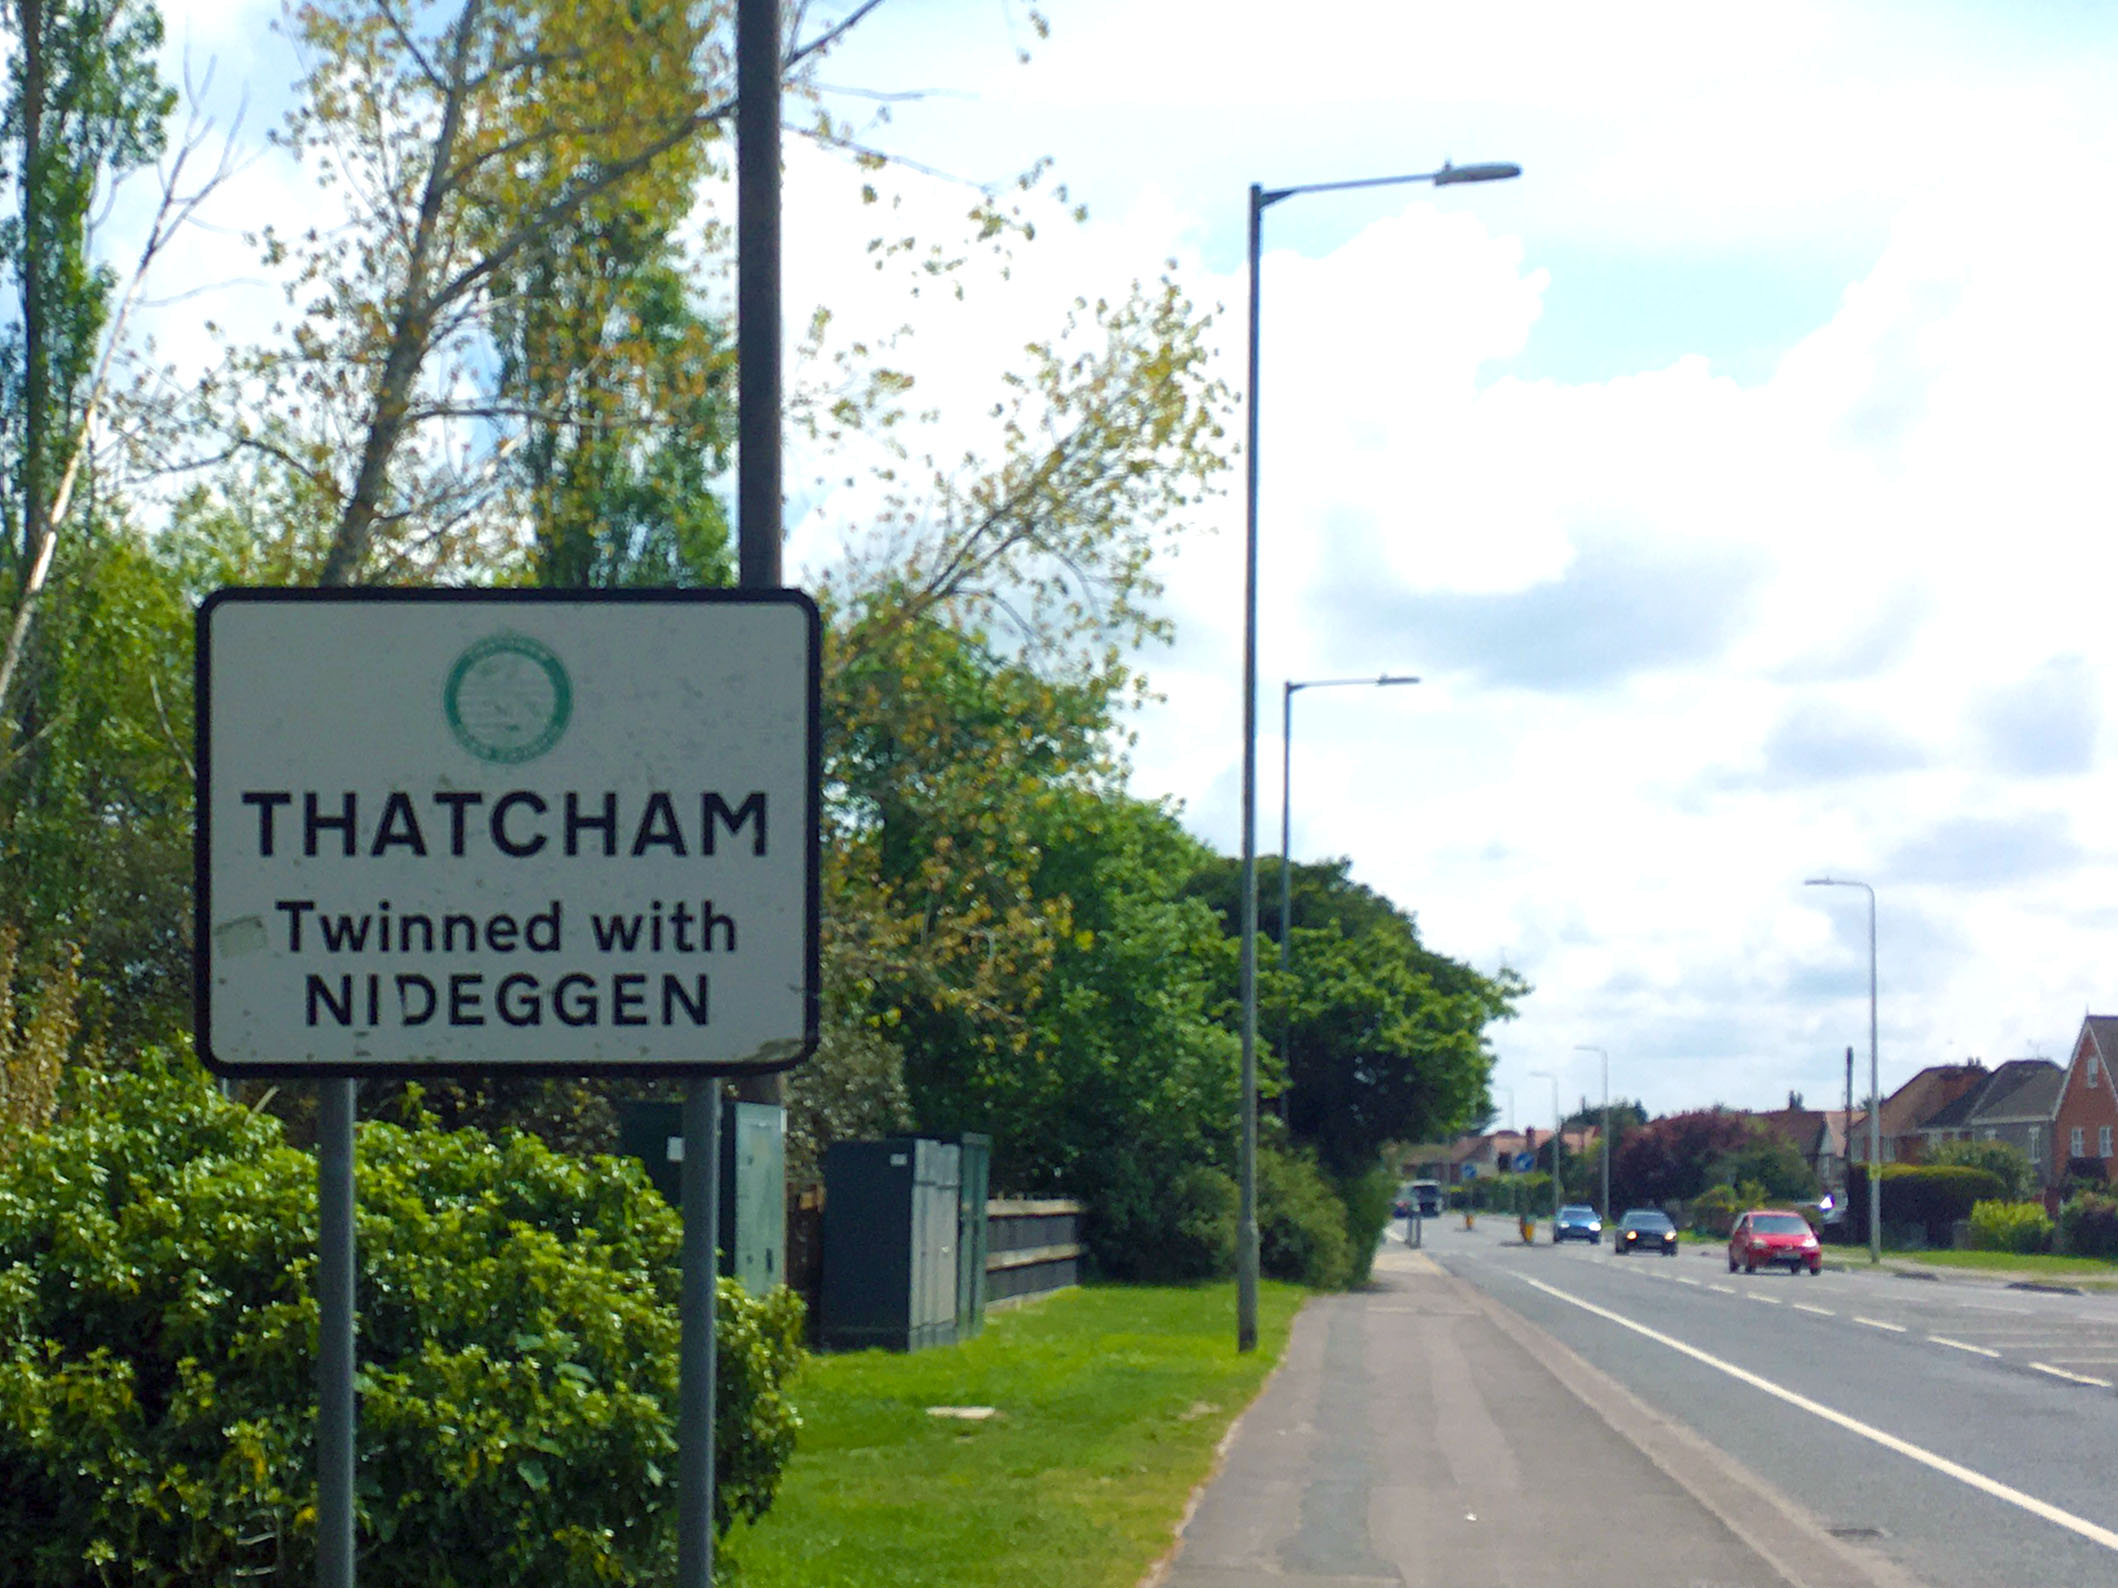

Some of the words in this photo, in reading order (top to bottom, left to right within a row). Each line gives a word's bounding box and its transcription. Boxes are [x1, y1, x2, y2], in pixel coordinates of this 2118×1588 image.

[242, 791, 768, 857] THATCHAM
[276, 900, 562, 953] Twinned
[592, 901, 737, 953] with
[306, 973, 709, 1026] NIDEGGEN
